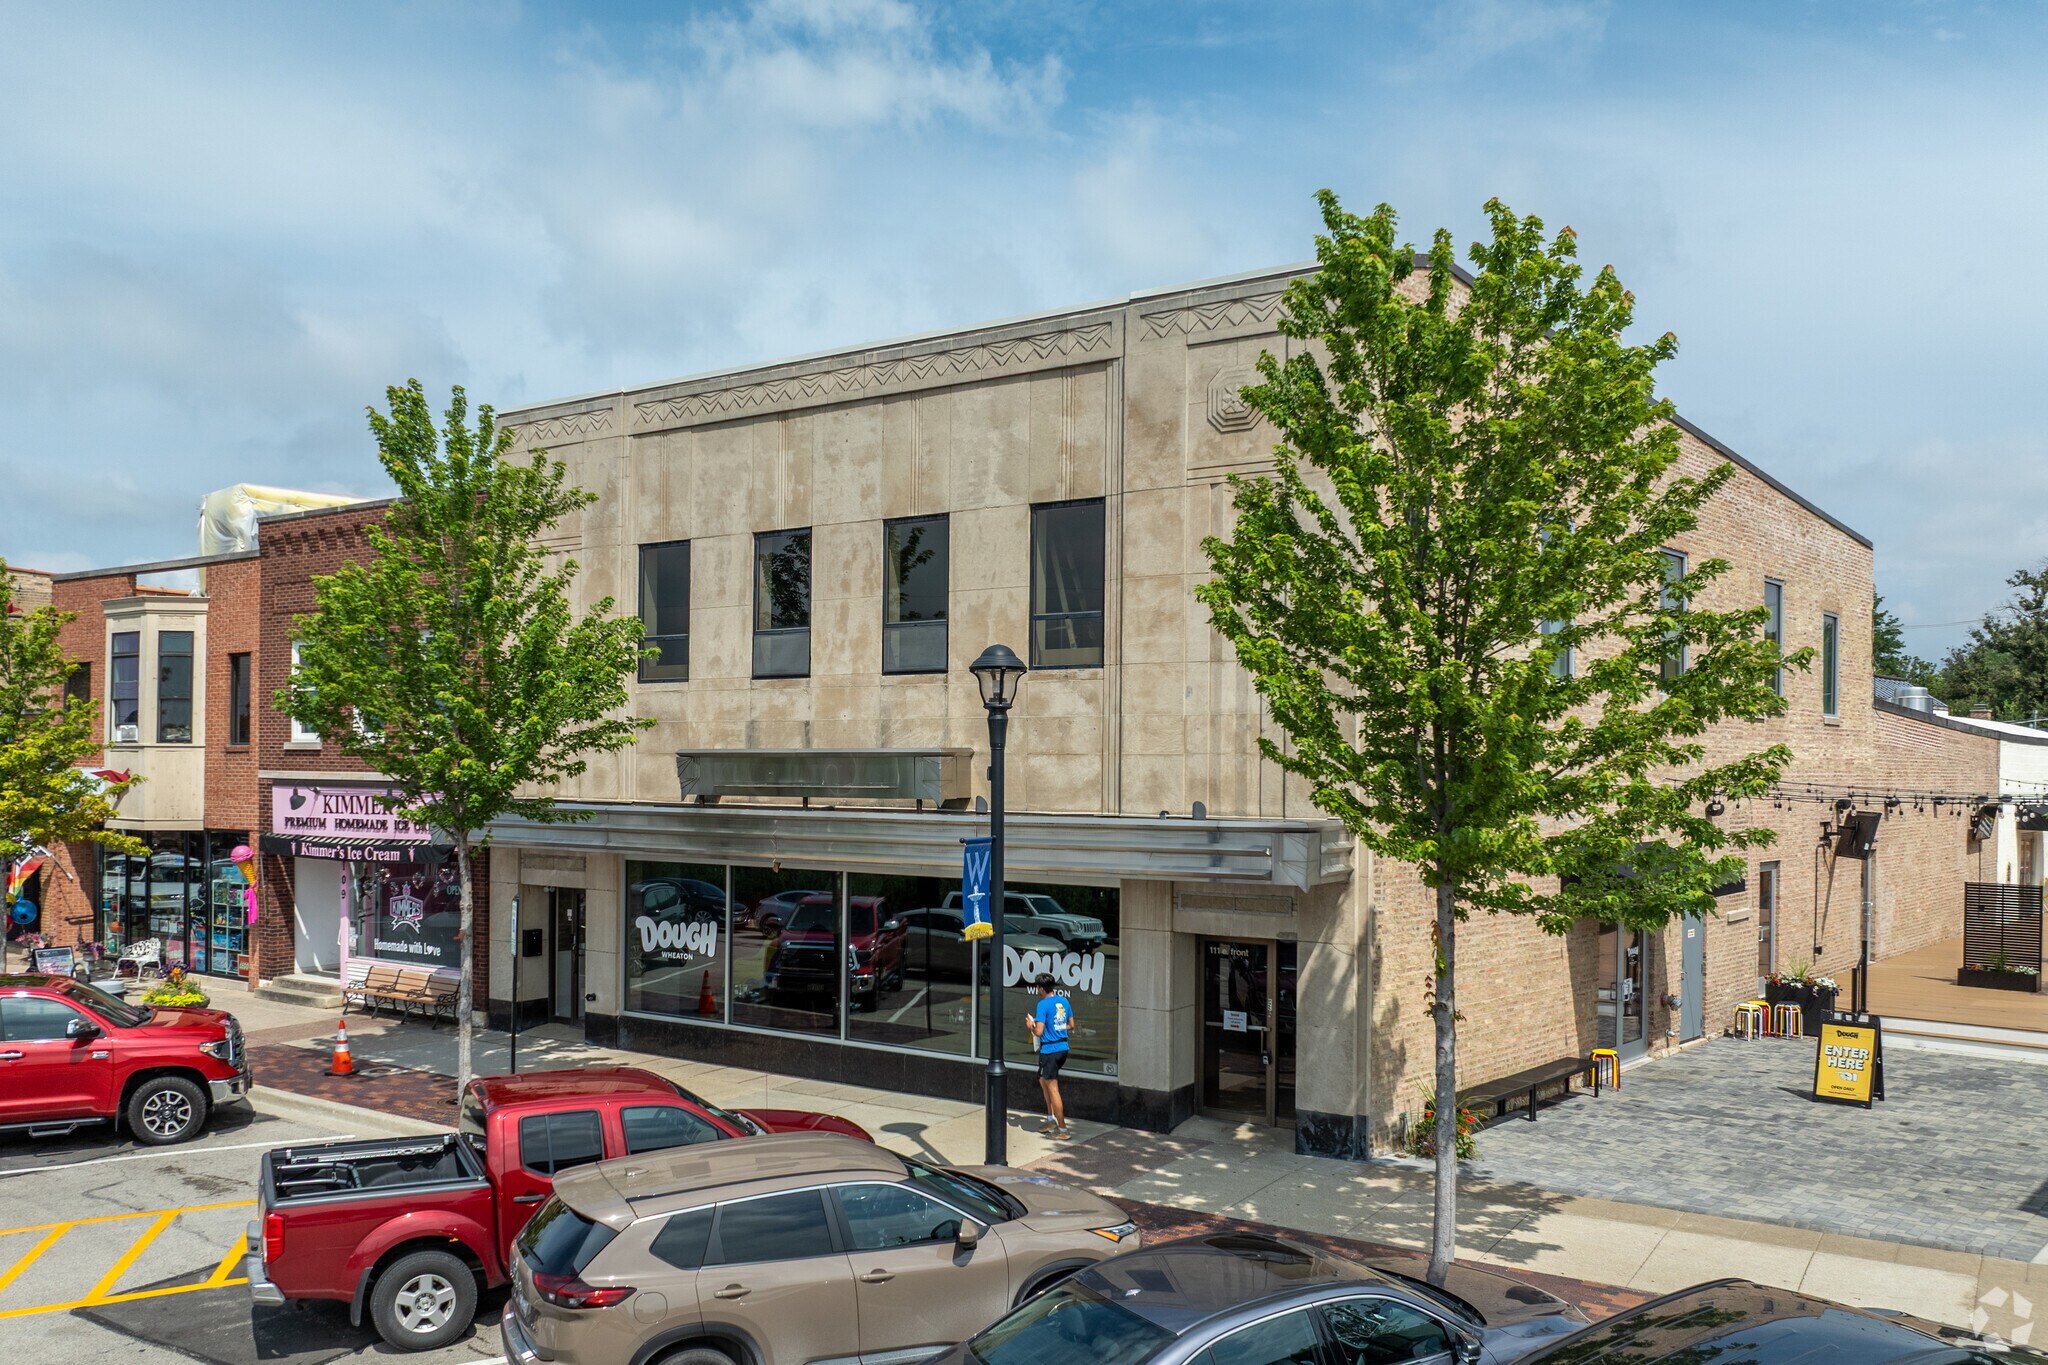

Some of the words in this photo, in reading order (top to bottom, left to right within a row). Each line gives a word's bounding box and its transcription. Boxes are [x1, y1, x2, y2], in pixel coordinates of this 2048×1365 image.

[284, 816, 327, 829] PREMIUM
[334, 818, 389, 831] HOMEMADE
[394, 820, 410, 831] ICE
[301, 842, 345, 859] Kimmer's
[347, 846, 362, 860] Ice
[364, 847, 401, 861] Cream
[966, 850, 990, 887] W
[635, 915, 718, 958] DOUGH
[374, 938, 408, 953] Homemade
[409, 942, 423, 955] with
[1230, 948, 1249, 957] front
[661, 951, 693, 960] WHEATON
[1003, 944, 1105, 995] DOUGH
[1026, 985, 1071, 998] WTON
[1824, 1044, 1870, 1060] ENTER
[1827, 1056, 1864, 1071] HERE
